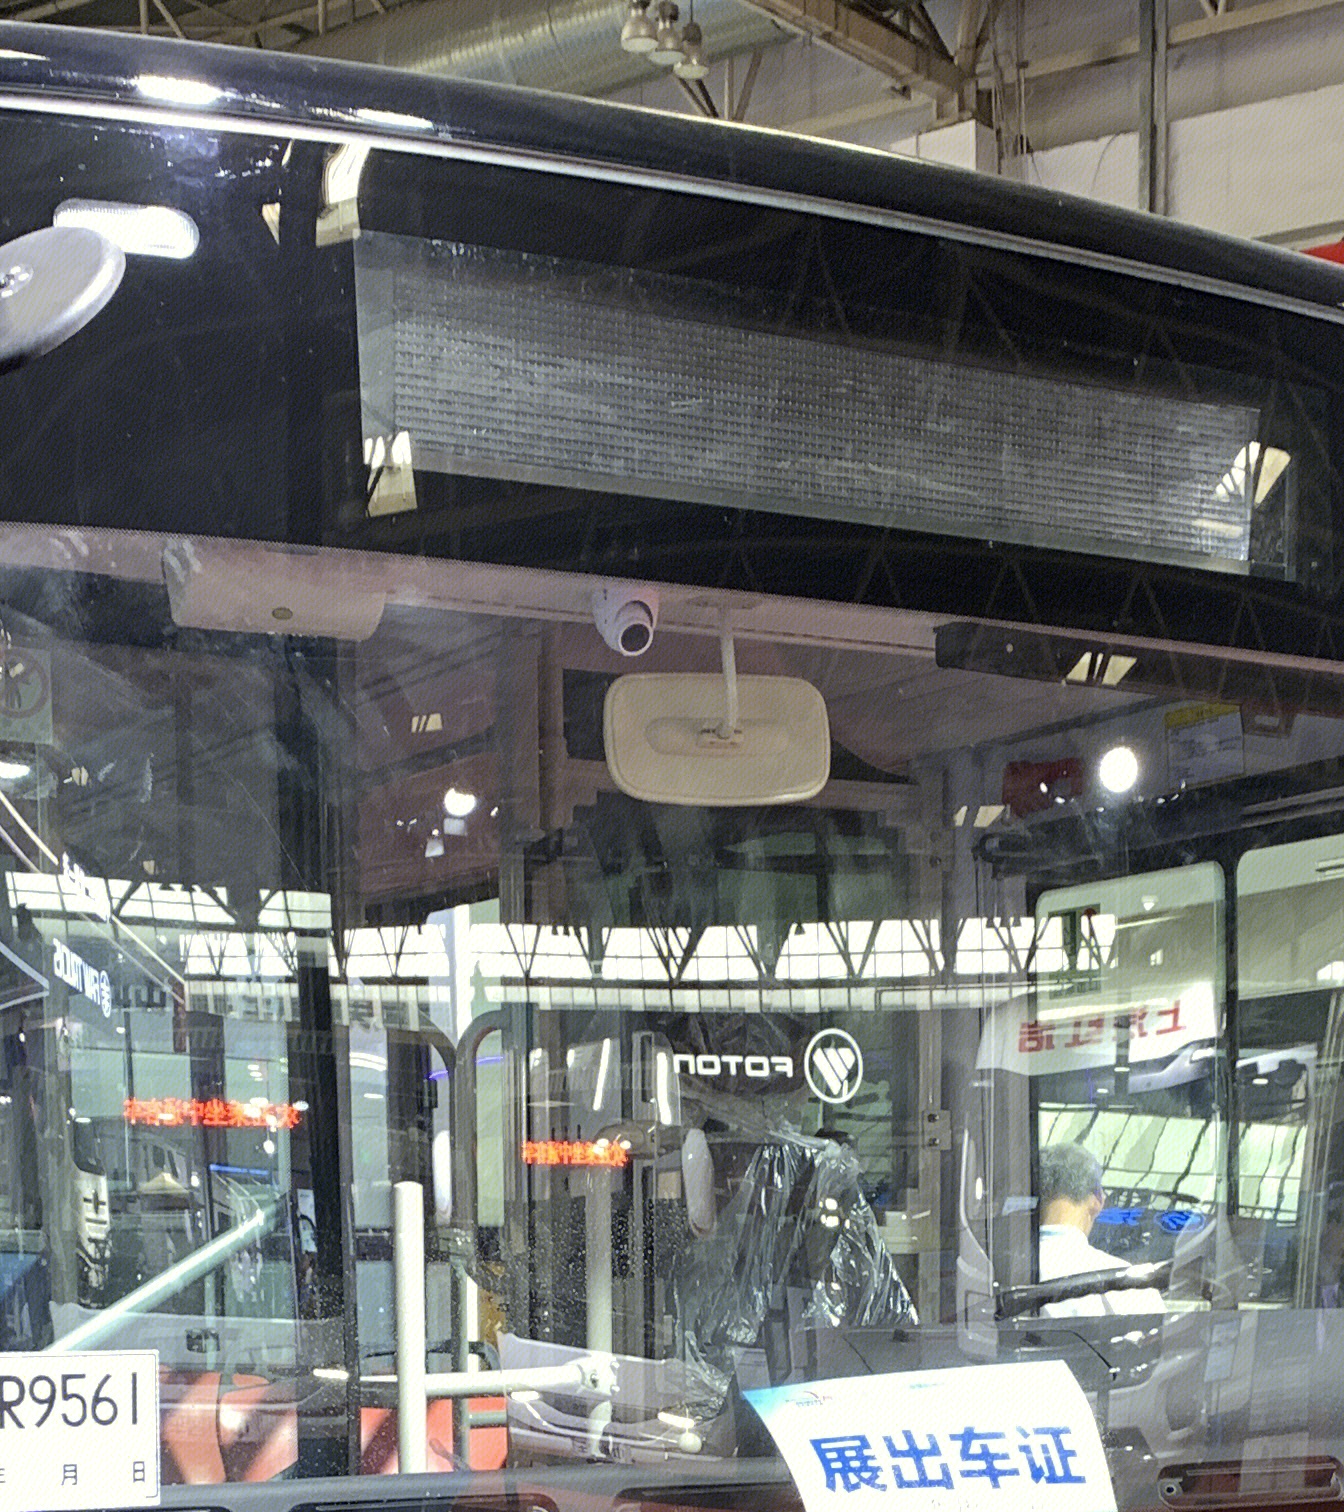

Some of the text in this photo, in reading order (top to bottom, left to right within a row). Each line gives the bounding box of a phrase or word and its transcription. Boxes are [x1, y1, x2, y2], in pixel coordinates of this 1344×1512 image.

[61, 1464, 77, 1486] 月
[133, 1461, 145, 1483] 日
[809, 1425, 1087, 1493] 展出车证
